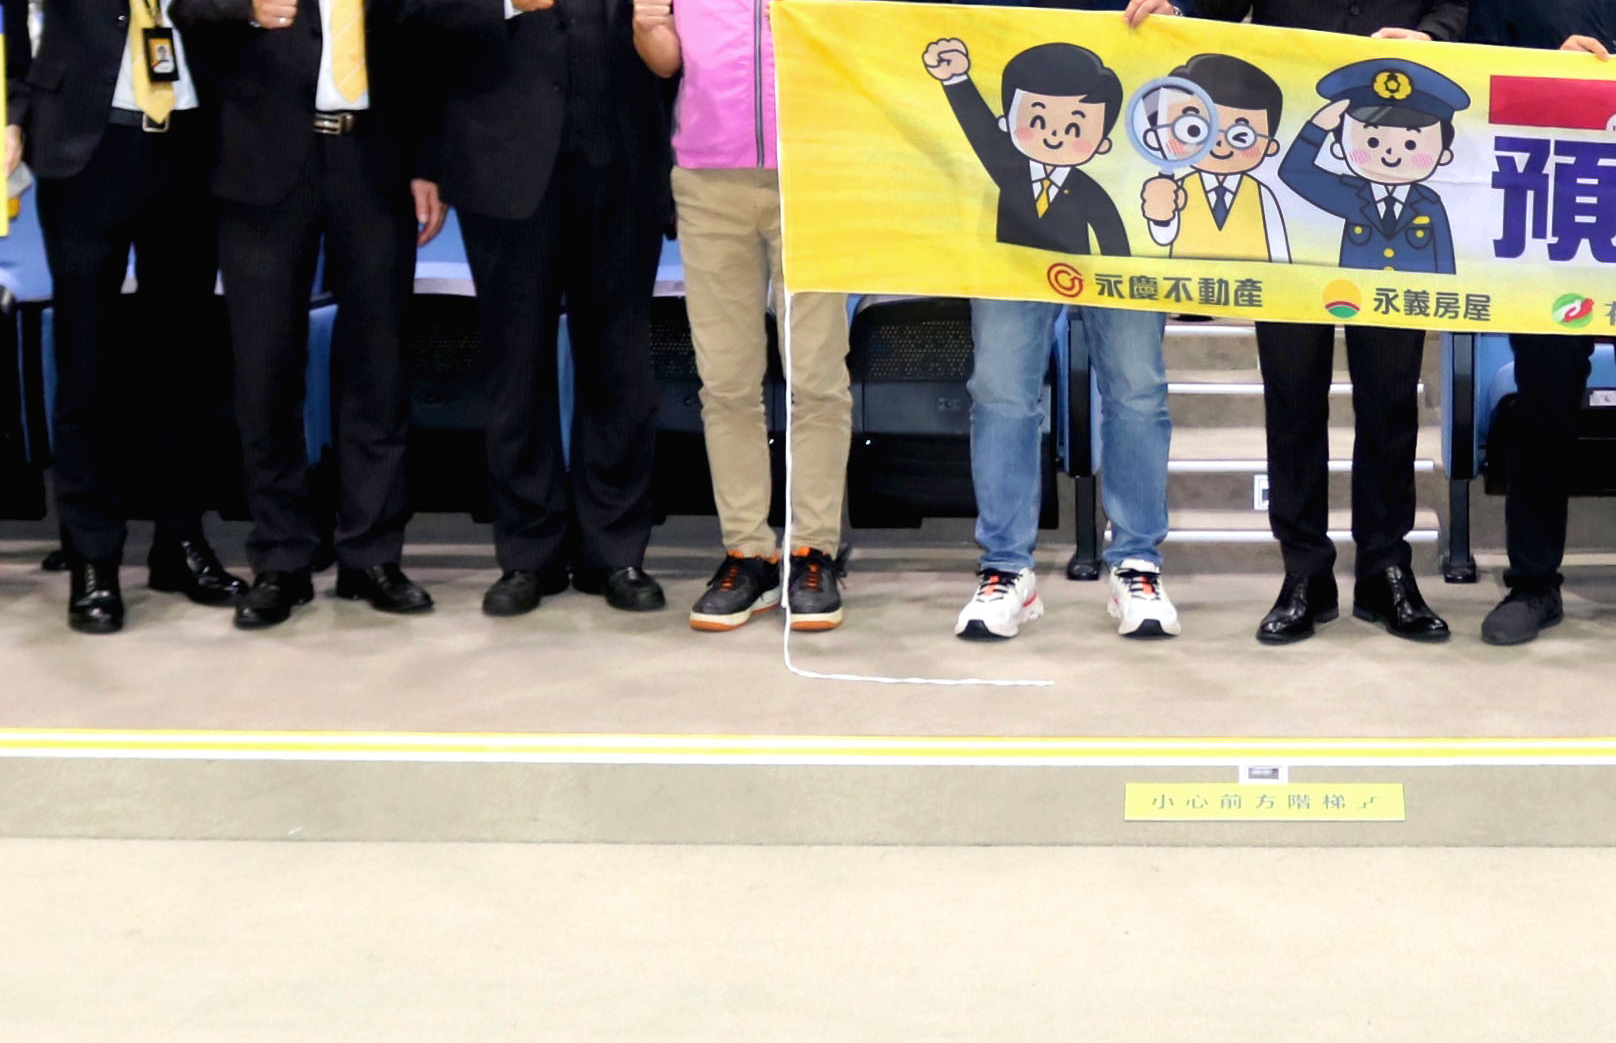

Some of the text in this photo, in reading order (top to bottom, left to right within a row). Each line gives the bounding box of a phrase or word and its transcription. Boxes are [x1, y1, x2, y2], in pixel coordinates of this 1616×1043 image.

[1094, 273, 1264, 308] 永慶不動產
[1372, 287, 1492, 323] 永義房屋
[1151, 793, 1346, 810] 小心前方階梯
